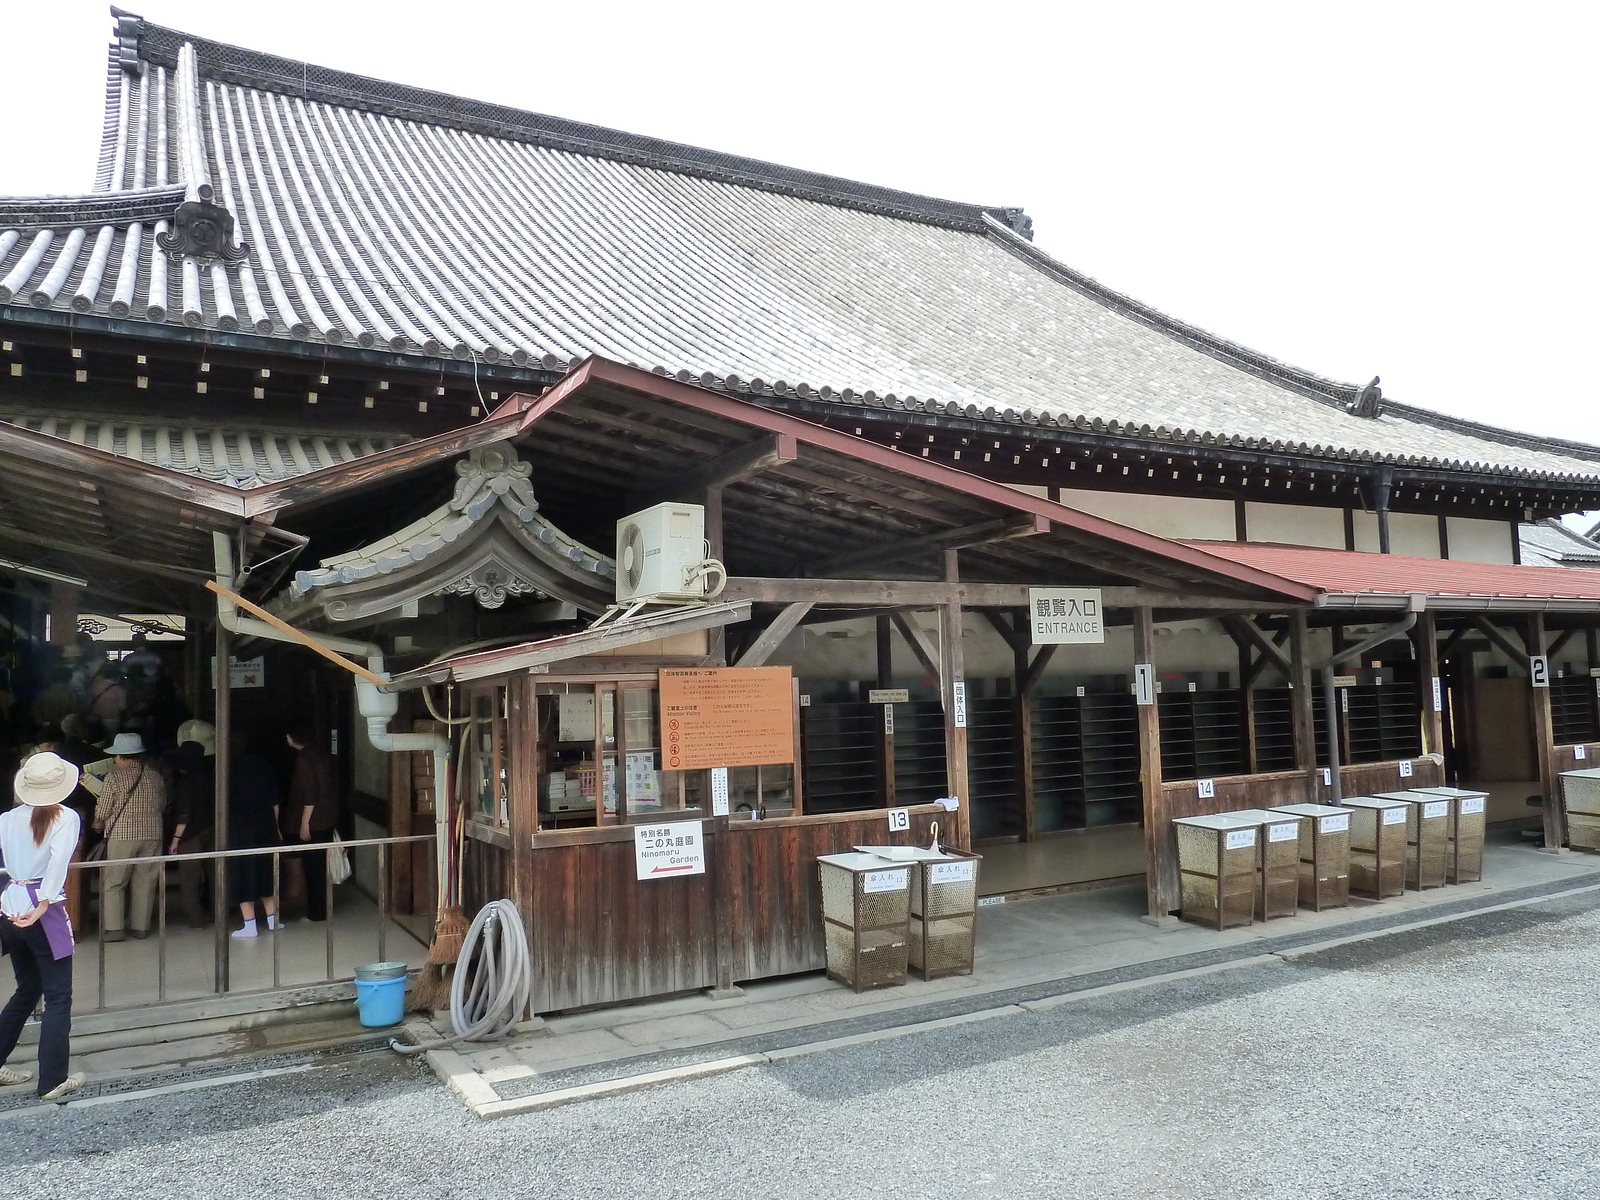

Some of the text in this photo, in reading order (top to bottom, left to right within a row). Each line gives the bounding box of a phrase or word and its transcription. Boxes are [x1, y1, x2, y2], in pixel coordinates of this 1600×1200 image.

[1036, 598, 1096, 617] 観覧入口
[1037, 622, 1098, 634] ENTRANCE
[1533, 658, 1545, 683] 2
[1140, 668, 1147, 700] 1
[801, 696, 809, 705] 14
[955, 686, 964, 723] 団体入口
[1401, 762, 1410, 774] 16
[1200, 782, 1212, 796] 14
[891, 812, 907, 828] 13
[640, 828, 671, 839] 特別名勝
[645, 835, 694, 849] 二の丸庭園
[641, 849, 680, 858] Ninomaru
[670, 855, 699, 864] Garden
[936, 864, 961, 874] 傘入れ
[870, 872, 894, 882] 傘入れ
[982, 897, 1002, 905] PLEASE
